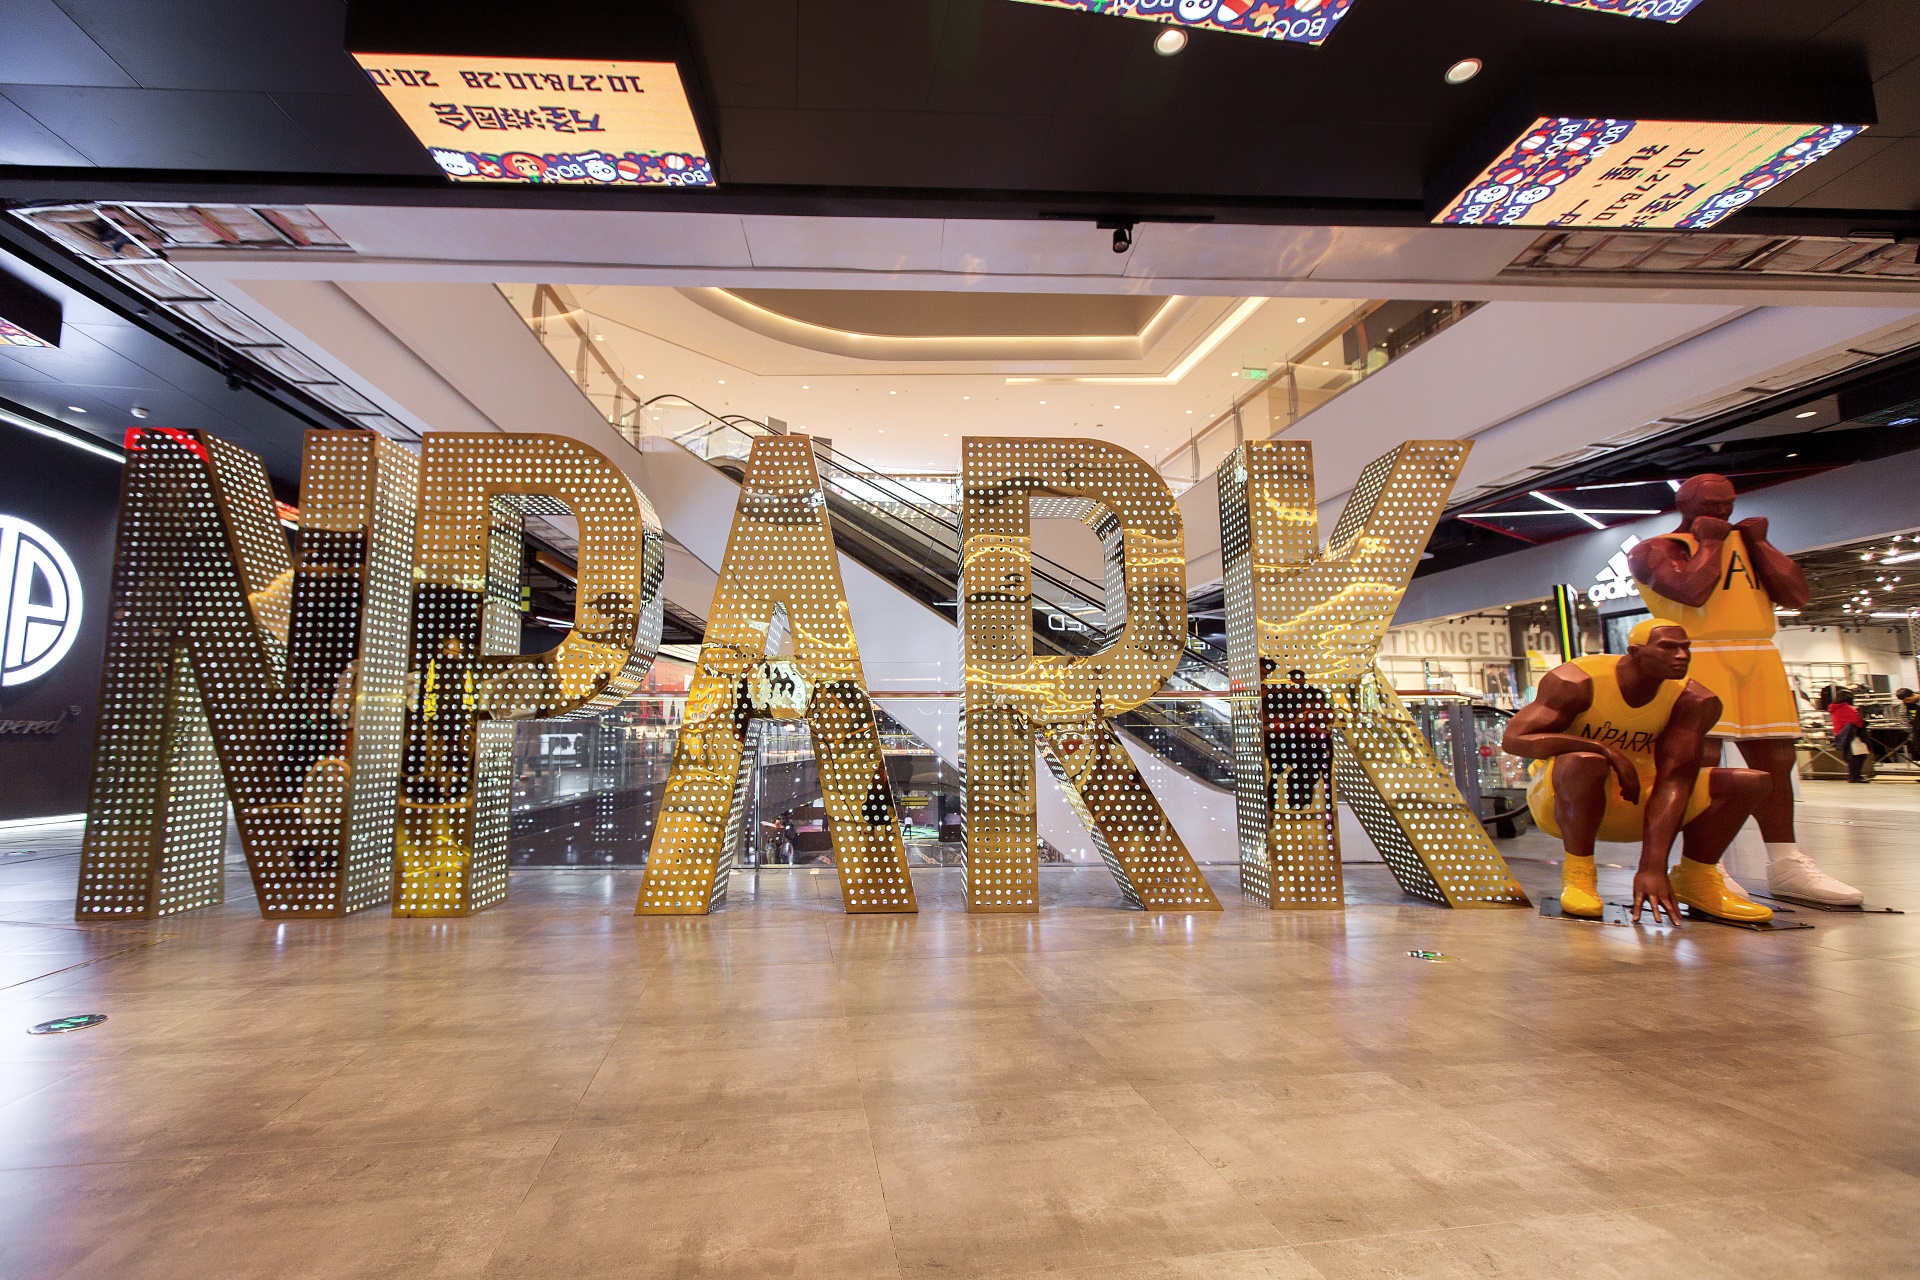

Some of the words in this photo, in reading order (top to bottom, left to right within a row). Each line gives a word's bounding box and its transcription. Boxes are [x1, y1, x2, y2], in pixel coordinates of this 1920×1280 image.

[458, 70, 645, 93] 10.27&10.28
[429, 101, 606, 133] 万圣游园会
